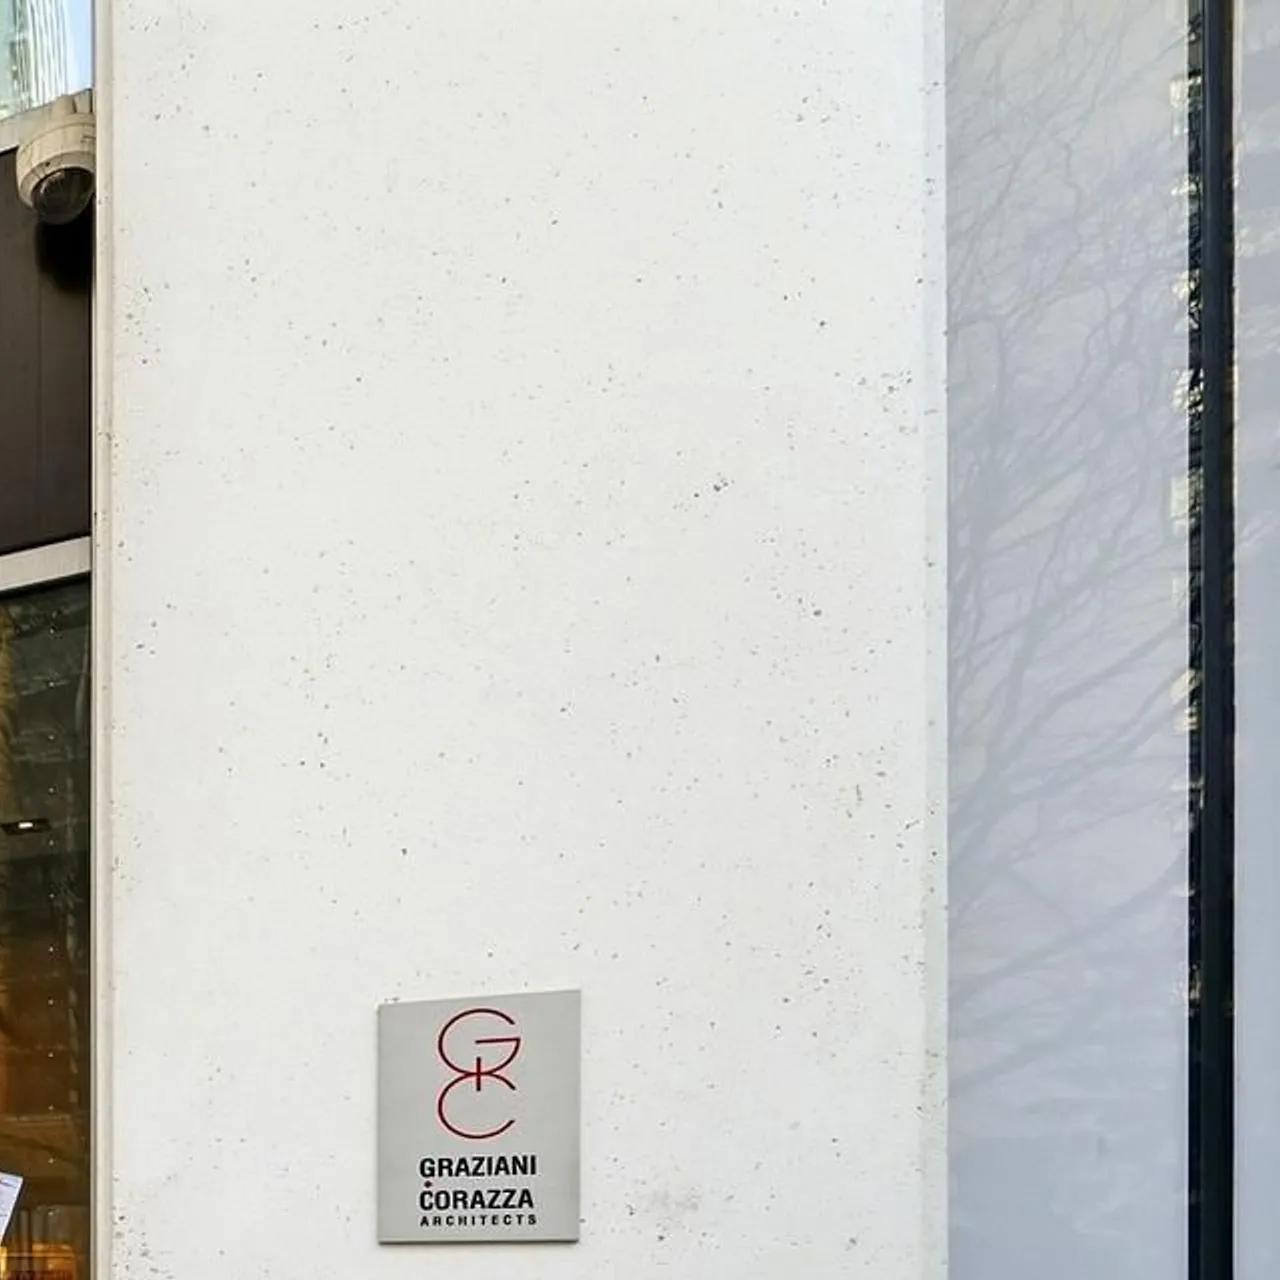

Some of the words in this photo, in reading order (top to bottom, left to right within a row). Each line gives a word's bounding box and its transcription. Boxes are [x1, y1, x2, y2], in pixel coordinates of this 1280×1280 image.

[420, 1155, 537, 1178] GRAZIANI
[419, 1189, 535, 1211] CORAZZA
[420, 1213, 538, 1227] ARCHITECTS
